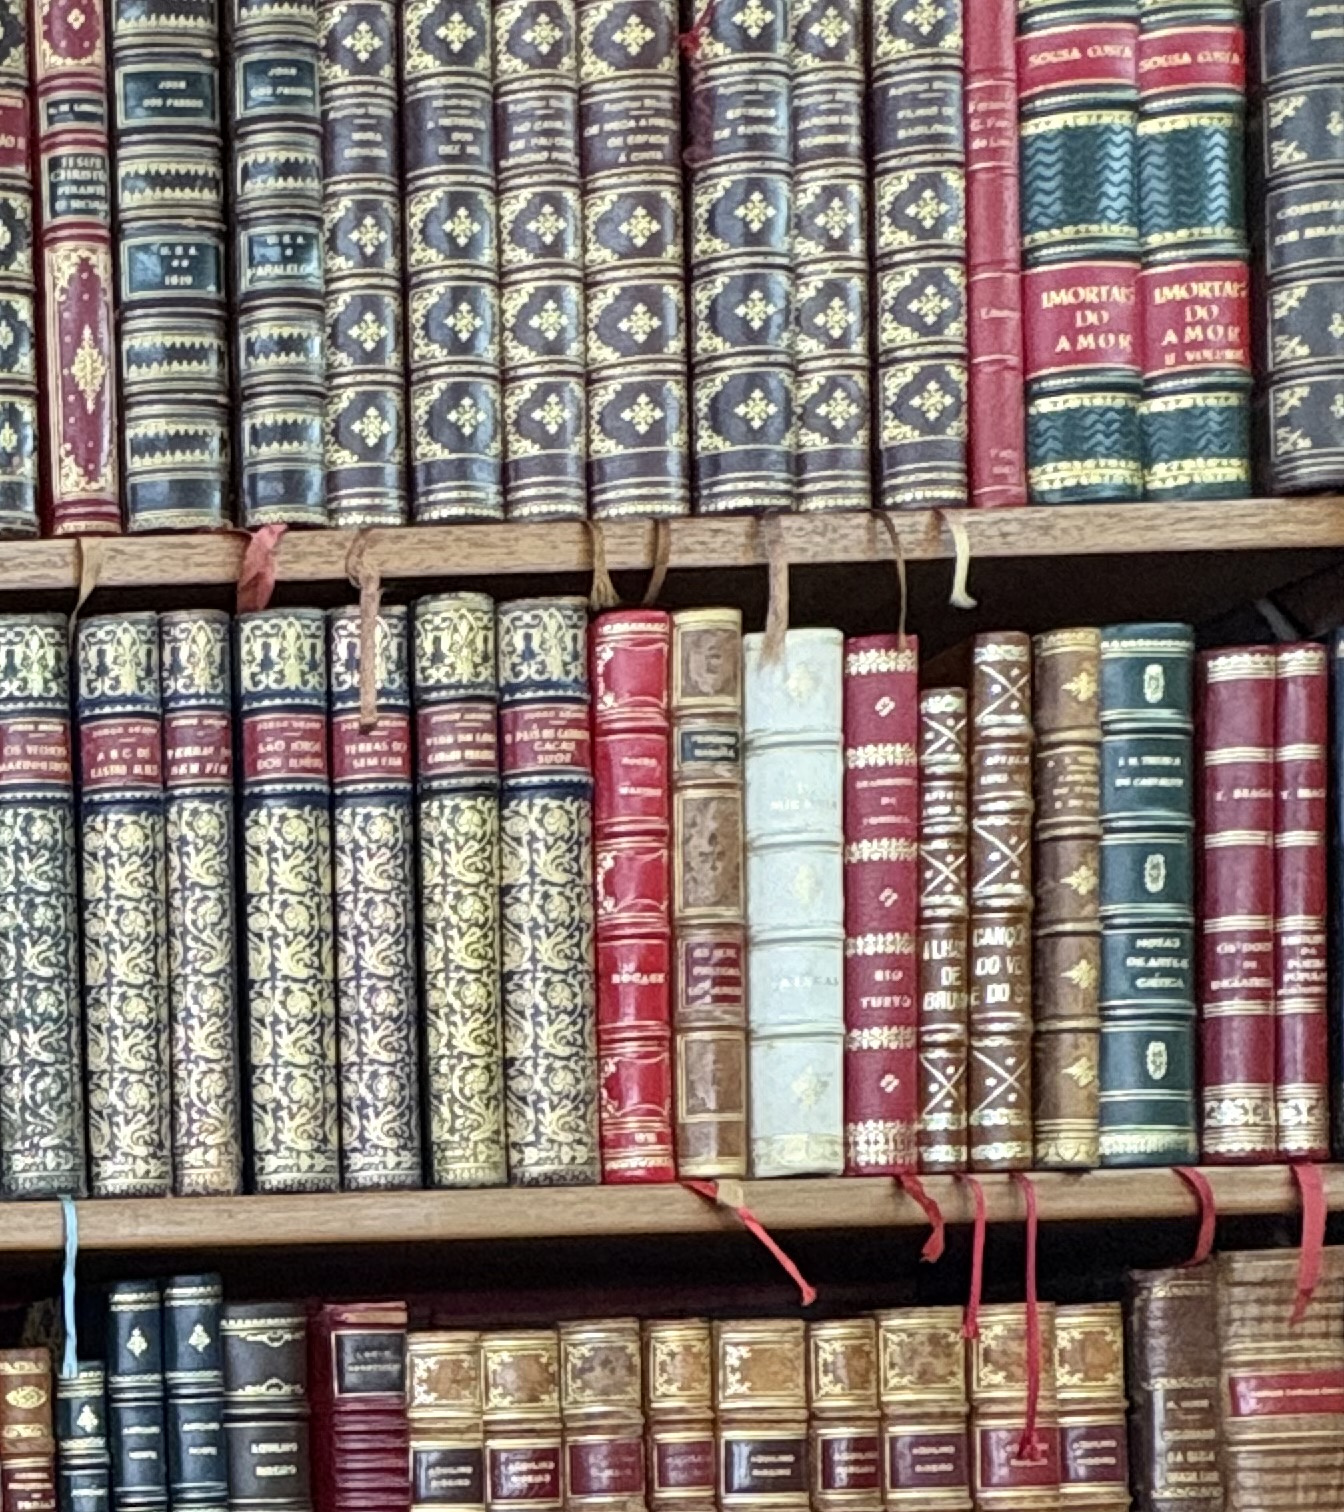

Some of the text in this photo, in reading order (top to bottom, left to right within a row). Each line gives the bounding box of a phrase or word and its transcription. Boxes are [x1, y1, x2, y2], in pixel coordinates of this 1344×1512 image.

[1028, 47, 1082, 66] SOUSA
[1139, 54, 1192, 73] SOUSA
[1074, 310, 1109, 328] DO
[1185, 304, 1219, 323] DO
[1055, 333, 1134, 353] AMOR
[1161, 325, 1241, 345] AMOR
